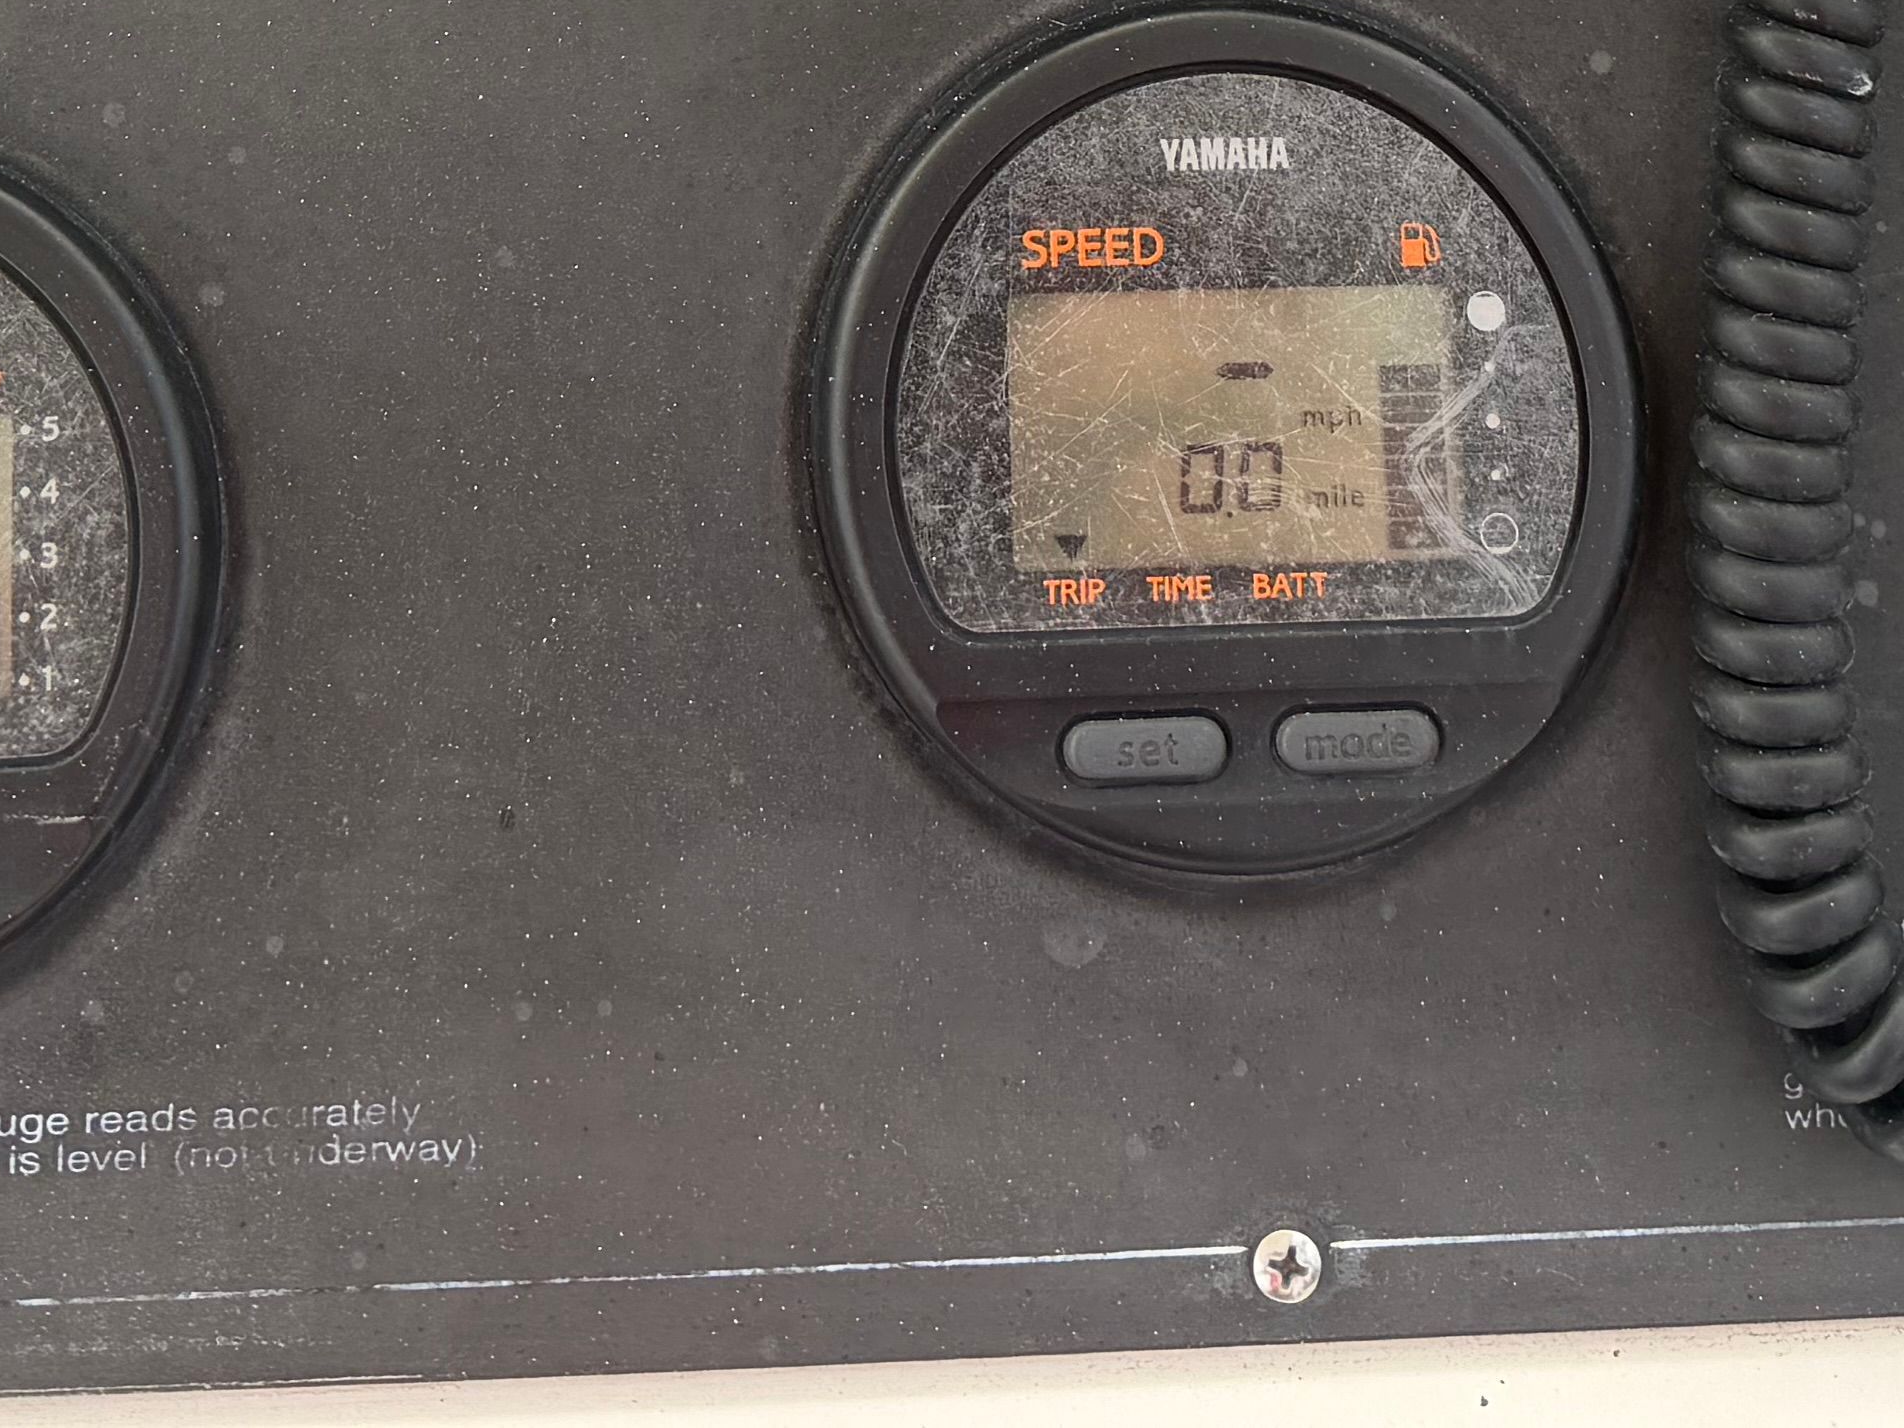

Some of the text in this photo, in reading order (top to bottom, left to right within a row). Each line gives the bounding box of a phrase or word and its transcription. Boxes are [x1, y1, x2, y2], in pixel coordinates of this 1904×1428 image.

[1161, 137, 1290, 171] YAMAHA
[1021, 227, 1164, 270] SPEED
[1303, 404, 1362, 430] mph
[1304, 484, 1364, 509] mile
[1044, 572, 1328, 606] TRIP TIME BATT
[1117, 726, 1414, 767] set mode
[84, 1102, 197, 1134] reads
[8, 1146, 41, 1175] is
[57, 1142, 147, 1172] level
